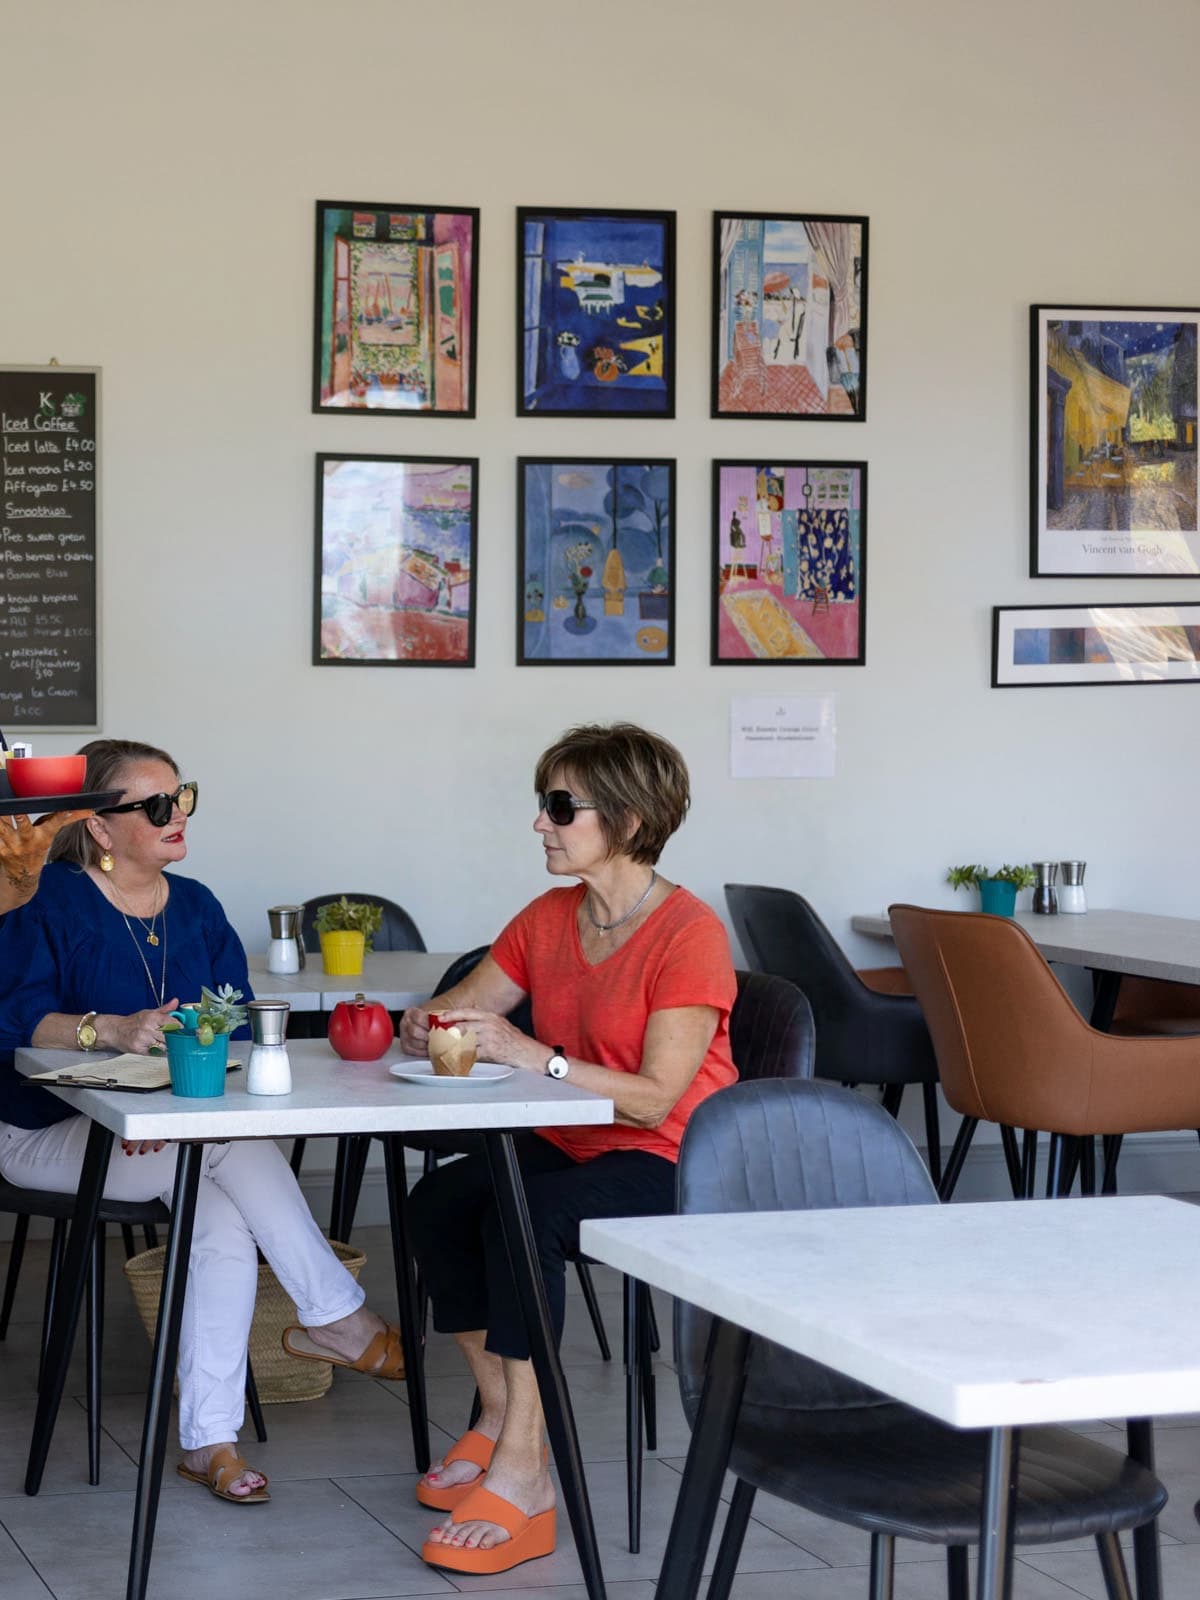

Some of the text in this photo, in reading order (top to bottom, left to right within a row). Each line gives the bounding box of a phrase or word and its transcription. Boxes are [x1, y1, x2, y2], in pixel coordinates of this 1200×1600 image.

[2, 412, 79, 432] Iced Coffee
[3, 436, 29, 453] Iced
[3, 457, 25, 476] Iced
[4, 479, 58, 498] Affogato
[5, 502, 72, 519] Smoothies
[1081, 543, 1163, 556] Vincent van Gogh
